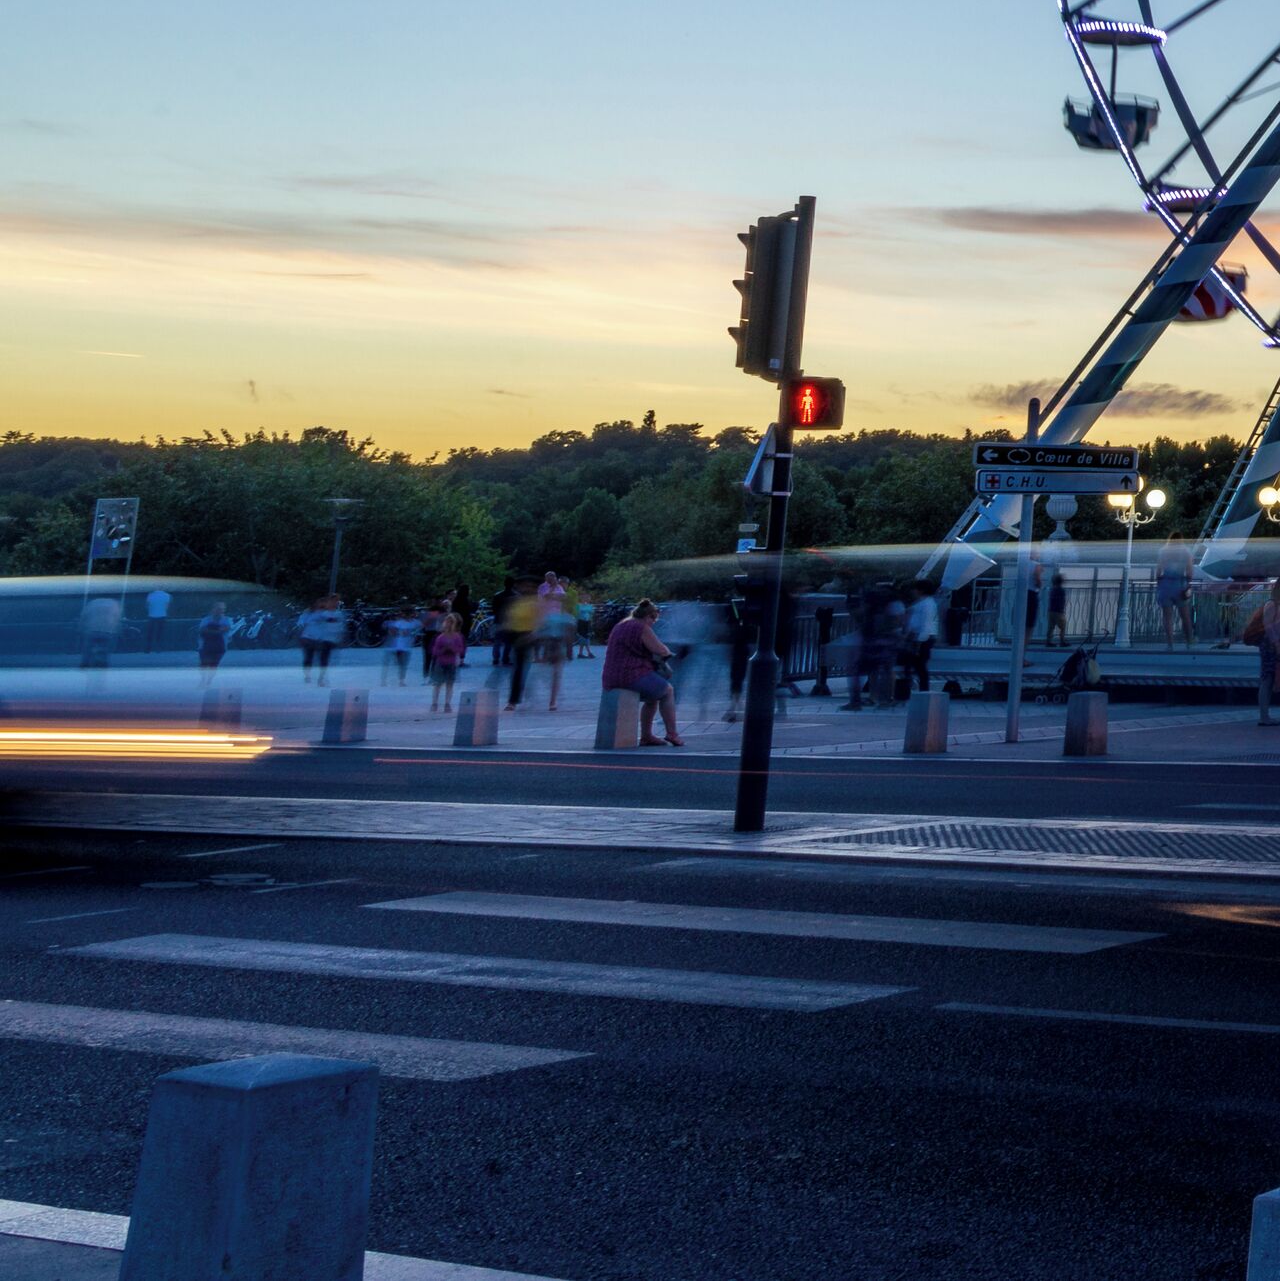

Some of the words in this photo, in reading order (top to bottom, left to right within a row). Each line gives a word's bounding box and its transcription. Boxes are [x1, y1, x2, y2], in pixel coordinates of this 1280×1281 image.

[1035, 451, 1071, 463] Cœur
[1077, 452, 1093, 464] de
[1100, 452, 1130, 465] Ville
[1006, 475, 1049, 488] C.H.U.
